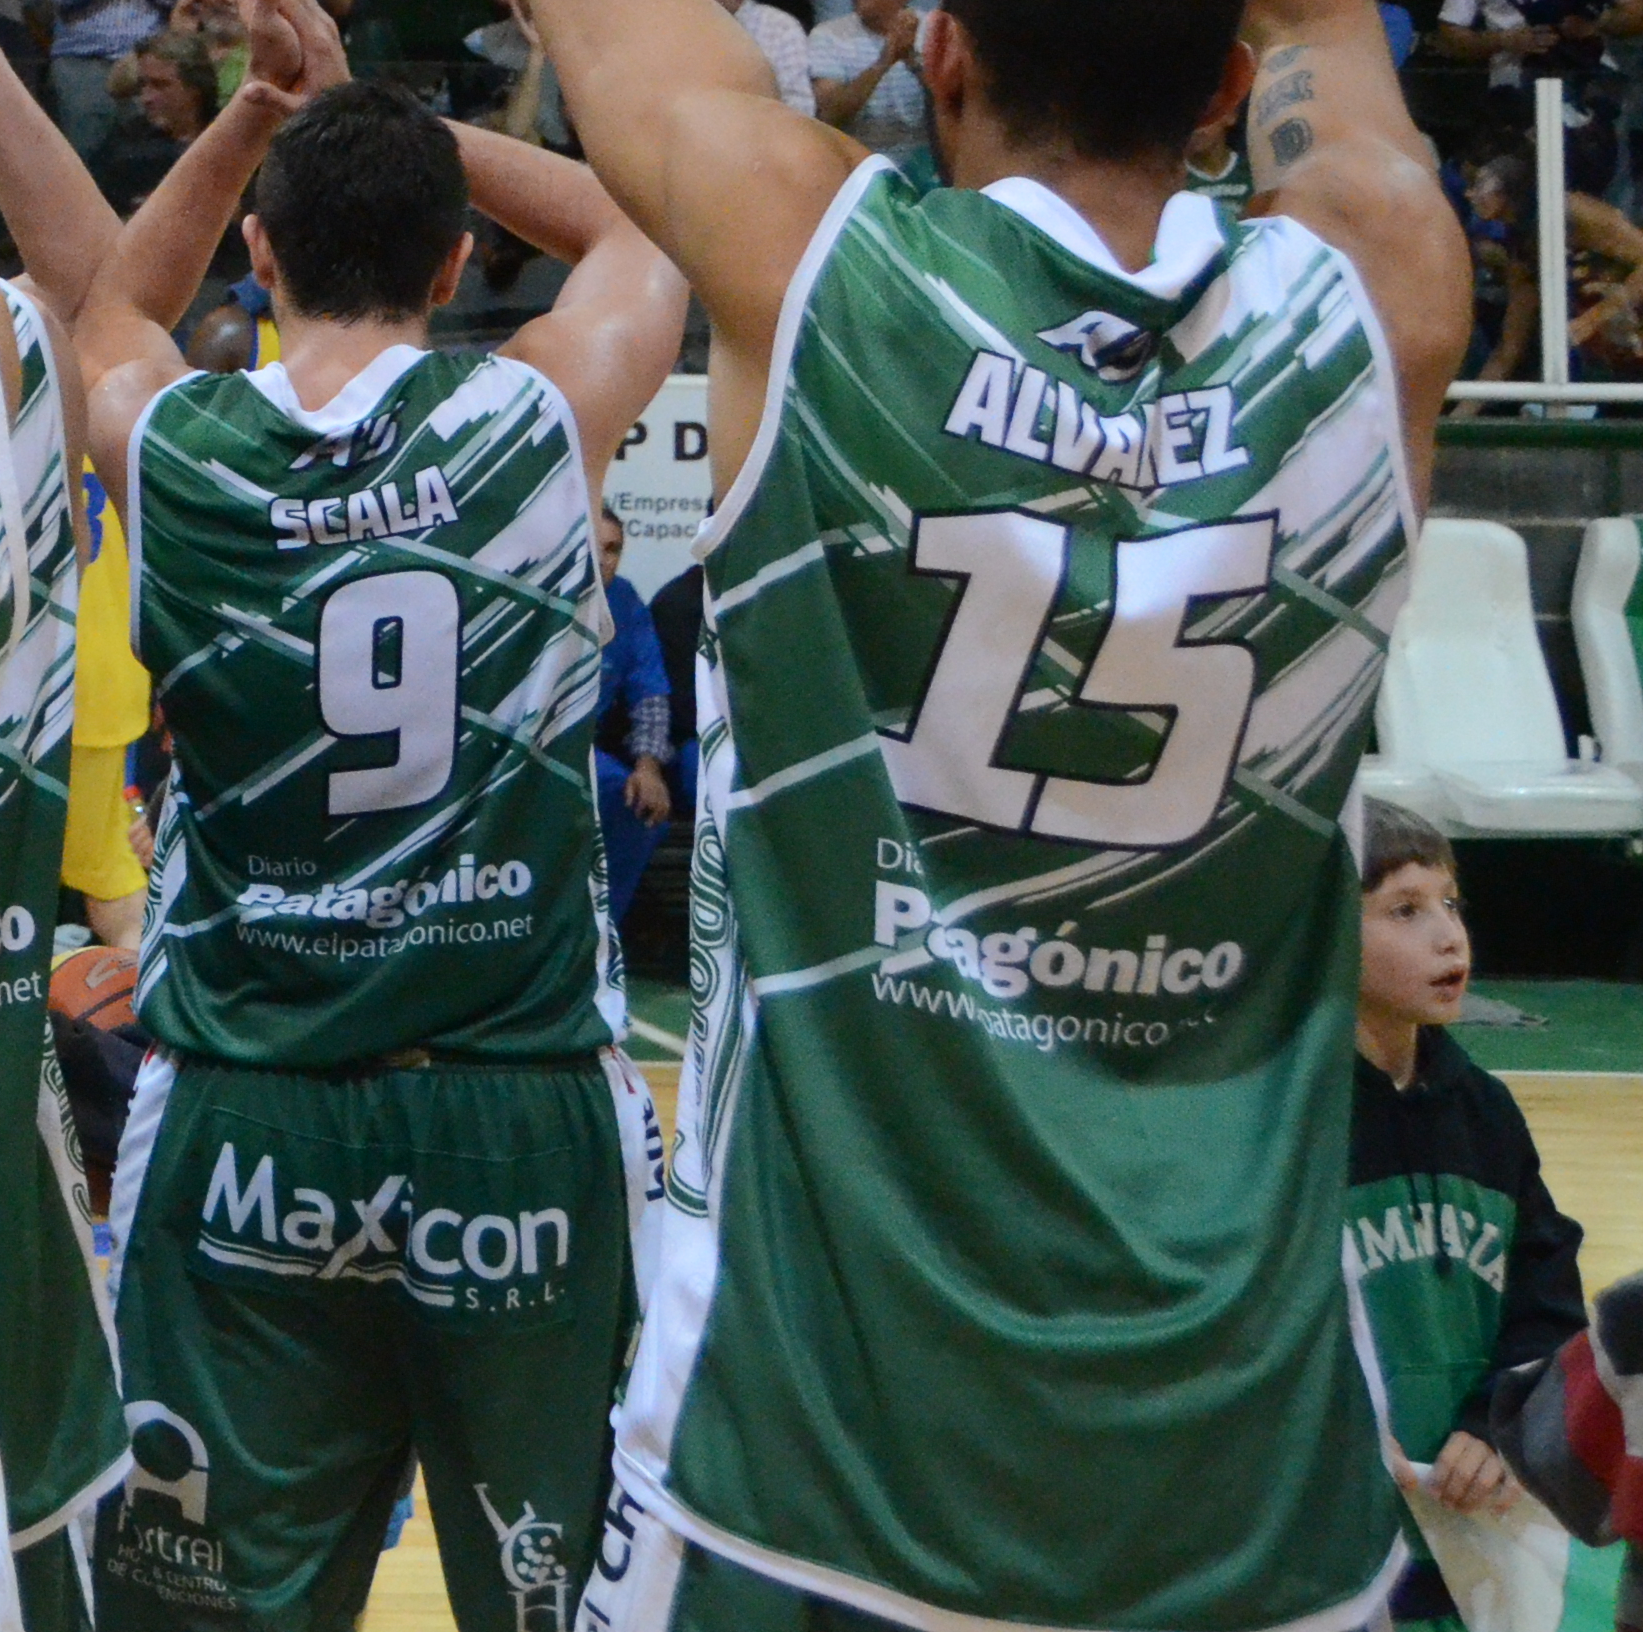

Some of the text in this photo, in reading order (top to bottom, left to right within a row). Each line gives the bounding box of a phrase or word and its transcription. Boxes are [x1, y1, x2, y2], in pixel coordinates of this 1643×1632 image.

[269, 466, 459, 550] SCALA
[619, 492, 709, 513] Empres
[319, 568, 465, 817] 9
[875, 508, 1279, 853] 15
[236, 853, 533, 930] Patagónico
[247, 854, 318, 876] Diario
[201, 1141, 570, 1279] Maxicon
